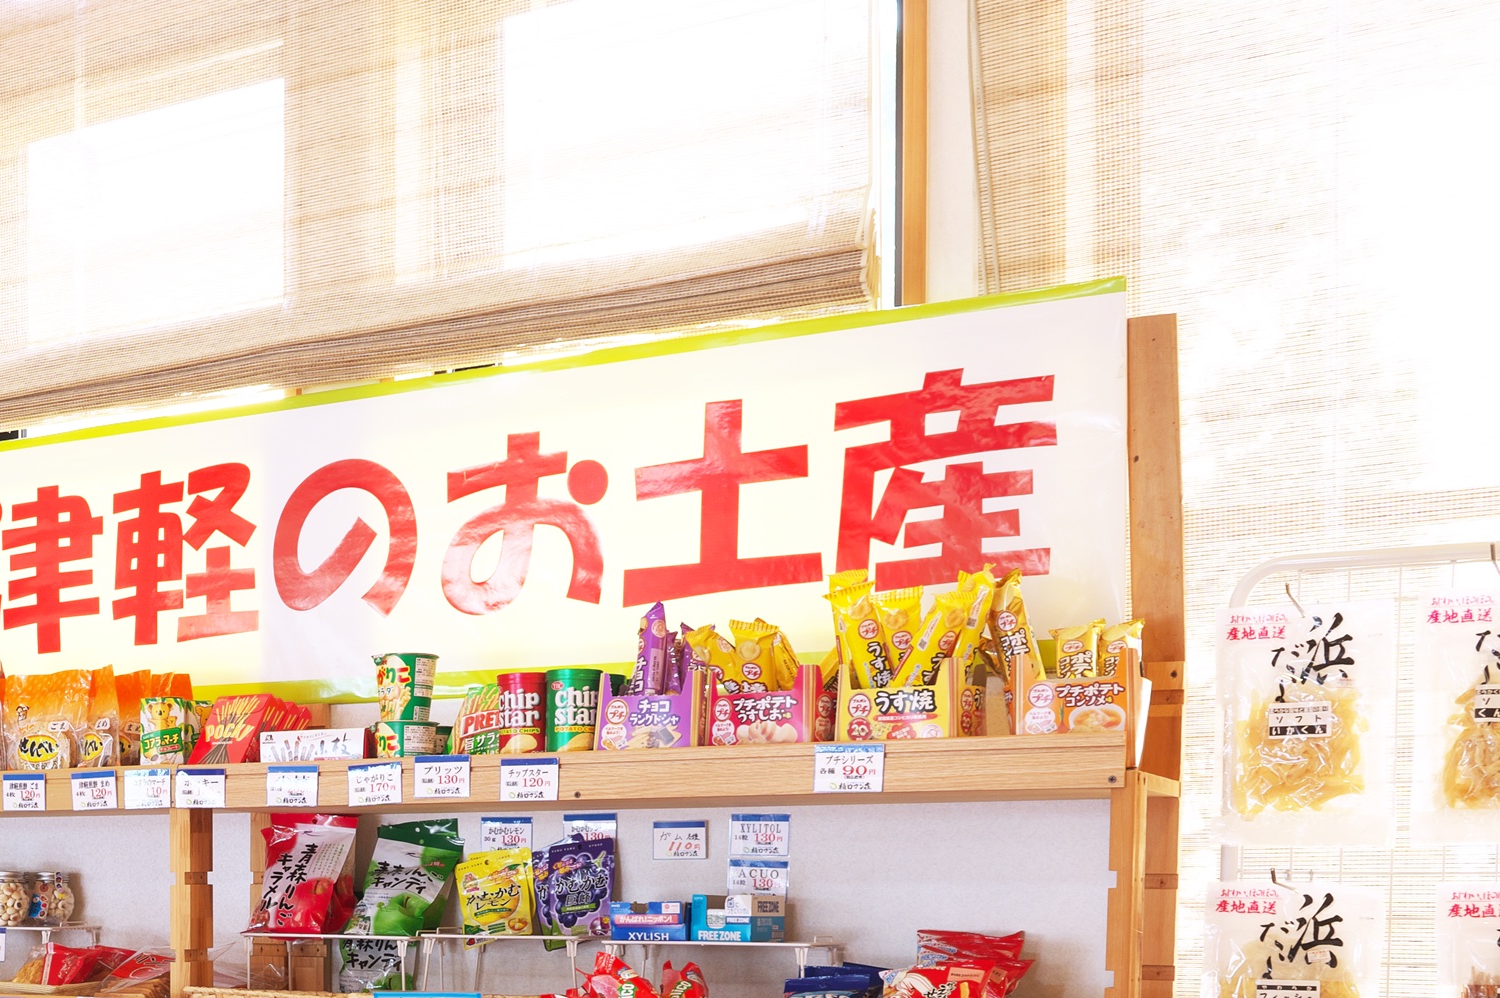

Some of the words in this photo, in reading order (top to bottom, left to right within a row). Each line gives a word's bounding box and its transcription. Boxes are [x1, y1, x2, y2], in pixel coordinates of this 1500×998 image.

[1426, 608, 1493, 624] 産地直送
[1225, 626, 1286, 641] 産地直送
[1299, 612, 1355, 685] 浜
[1055, 681, 1125, 696] プチポテト
[639, 699, 670, 712] チョコ
[732, 696, 797, 711] プチポテト
[875, 689, 936, 714] うす焼
[629, 713, 679, 726] ラングドシャ
[1275, 714, 1323, 724] ソフト
[205, 723, 255, 742] POCKY
[1270, 725, 1326, 736] いかくん
[19, 737, 59, 758] せんべい
[825, 755, 874, 765] プチシリーズ
[424, 766, 463, 775] プリッツ
[508, 768, 548, 777] チップスター
[842, 765, 876, 776] 90円
[356, 773, 393, 784] じゃがりこ
[438, 774, 465, 785] 130円
[522, 778, 550, 788] 120円
[90, 788, 112, 798] 120円
[370, 783, 396, 792] 170円
[20, 791, 40, 799] 120円
[488, 827, 525, 835] かむかむレモン
[740, 823, 782, 834] XYLITOL
[501, 835, 527, 844] 130円
[755, 833, 783, 842] 130円
[738, 868, 779, 880] ACUO
[555, 875, 608, 895] かむかむ
[466, 884, 521, 905] かむかむ
[1215, 901, 1277, 915] 産地直送
[628, 932, 669, 940] XYLISH
[1289, 892, 1344, 969] 浜
